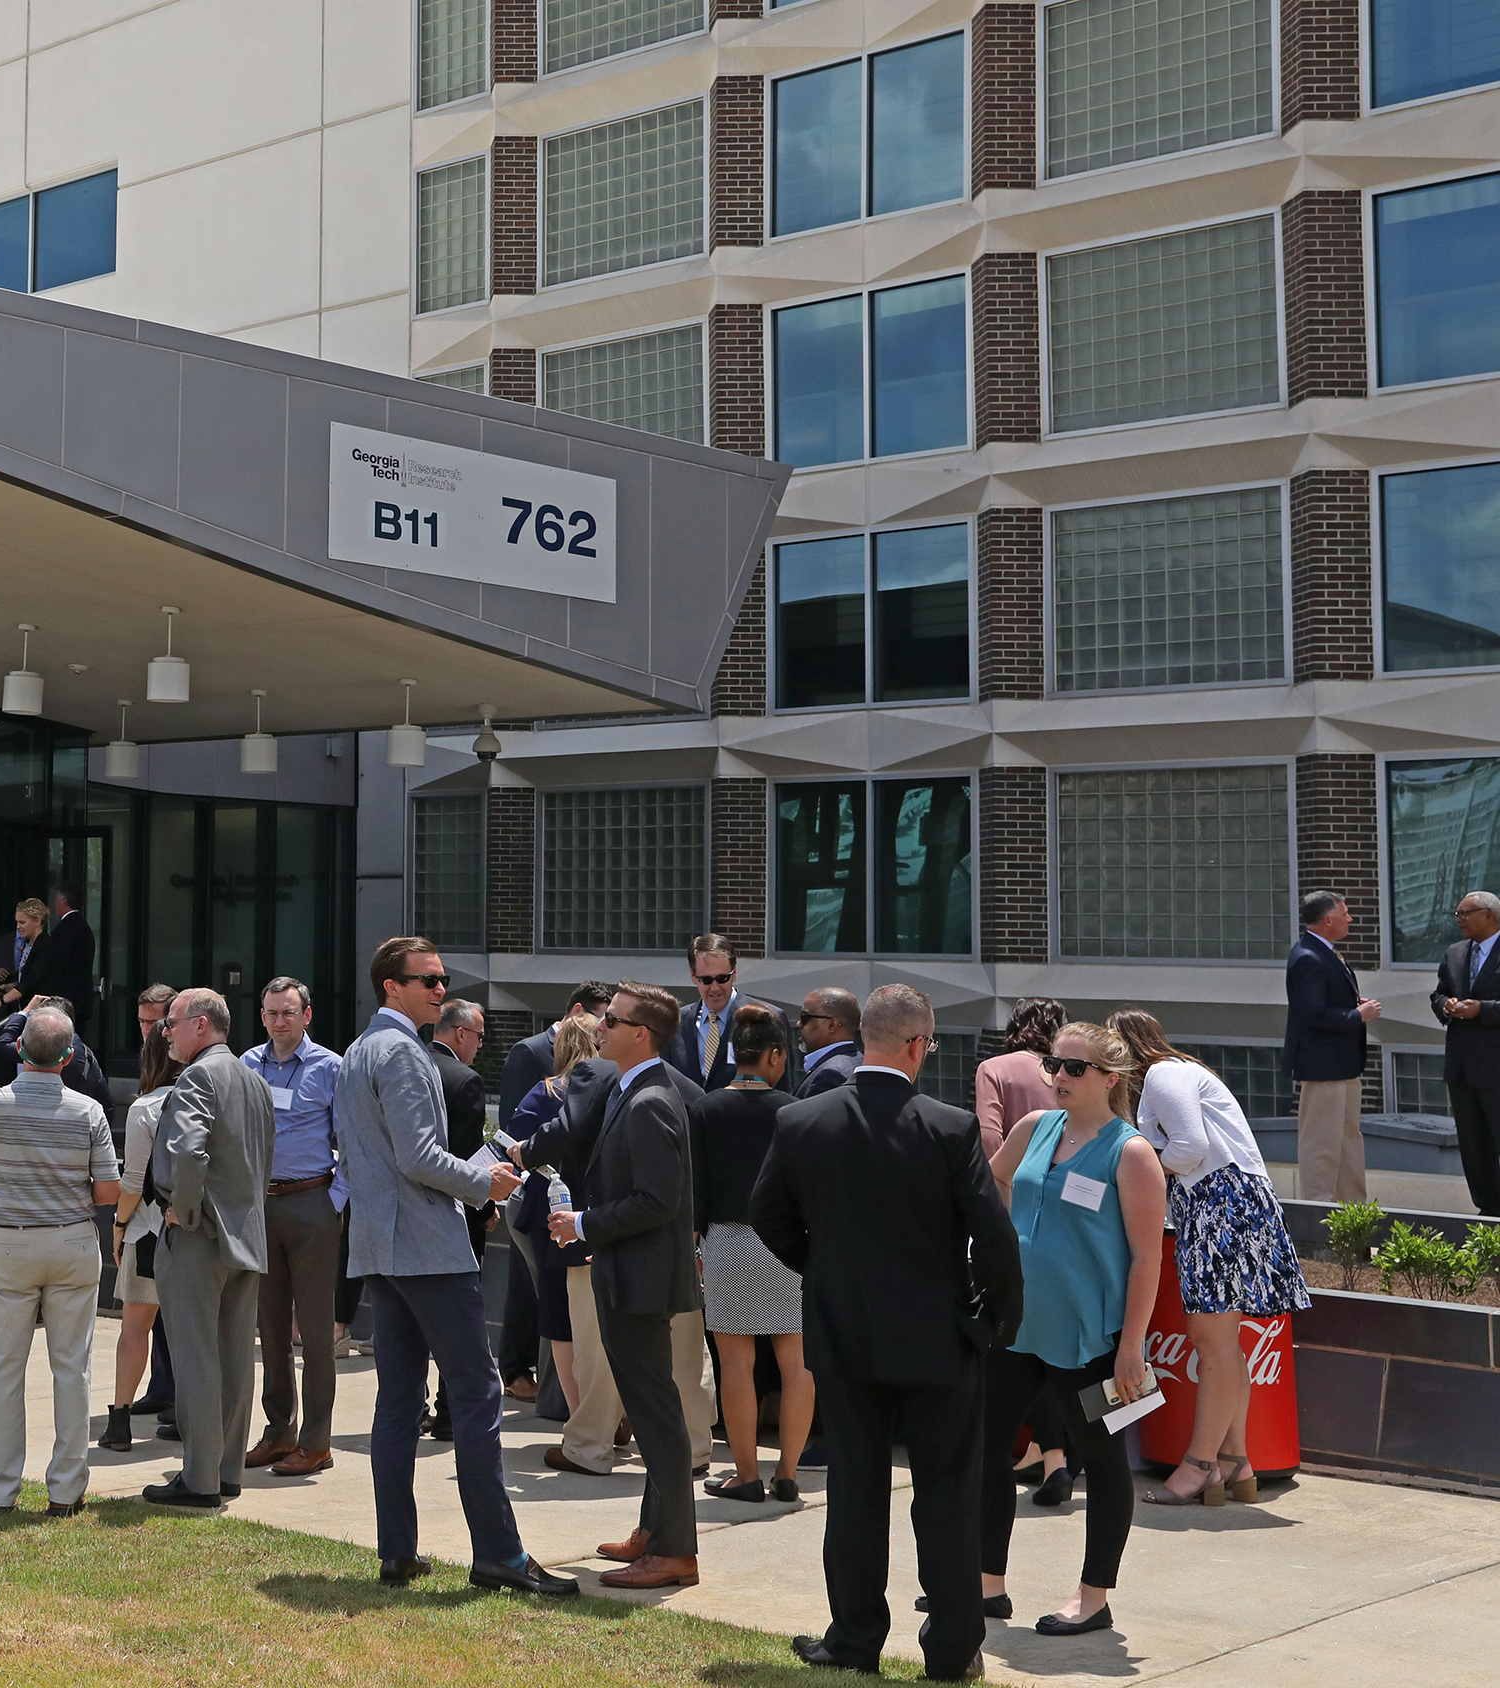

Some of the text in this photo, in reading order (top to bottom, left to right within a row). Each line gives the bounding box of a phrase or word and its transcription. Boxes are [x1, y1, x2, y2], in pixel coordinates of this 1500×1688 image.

[351, 448, 400, 469] Georgia
[370, 464, 400, 481] Tech
[407, 459, 462, 481] Research
[407, 472, 456, 492] Institute
[374, 500, 438, 548] B11
[501, 496, 597, 559] 762
